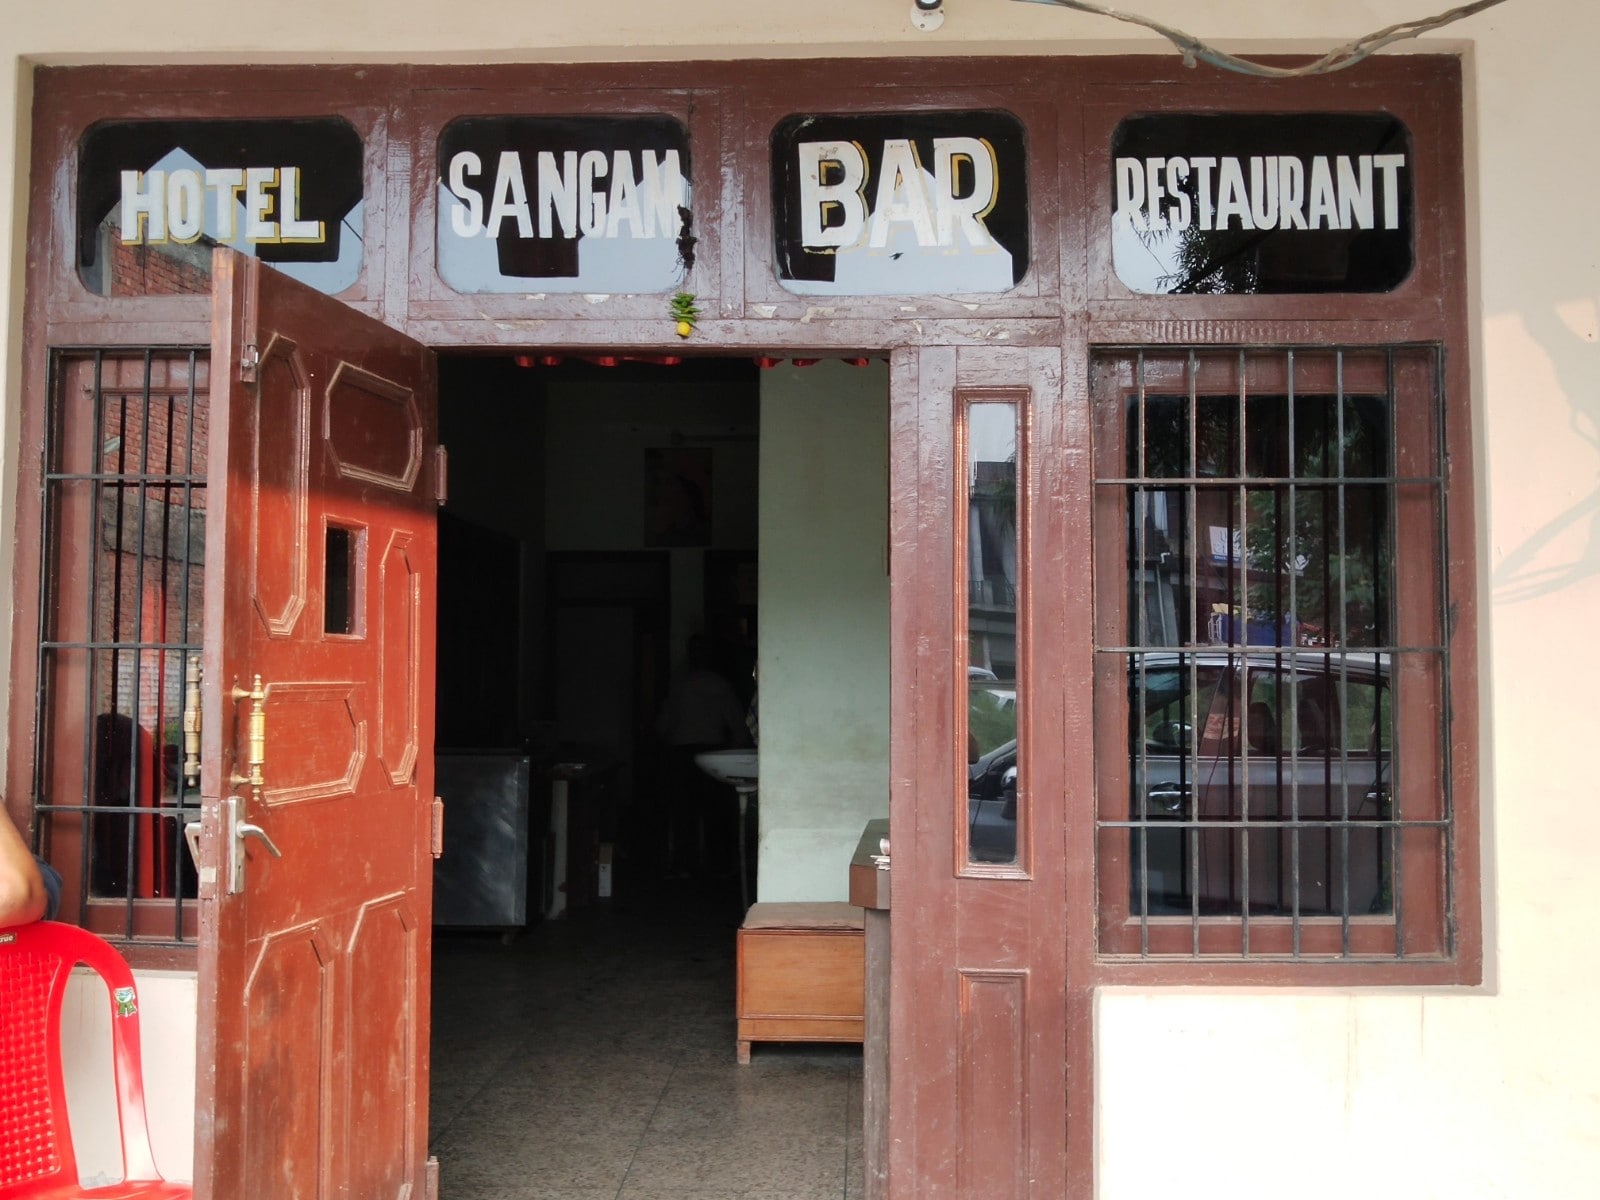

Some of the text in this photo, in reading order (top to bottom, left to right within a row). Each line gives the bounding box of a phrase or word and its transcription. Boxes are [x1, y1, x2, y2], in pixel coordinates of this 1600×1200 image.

[121, 137, 1405, 255] HOTEL SANGAM BAR RESTAURANT
